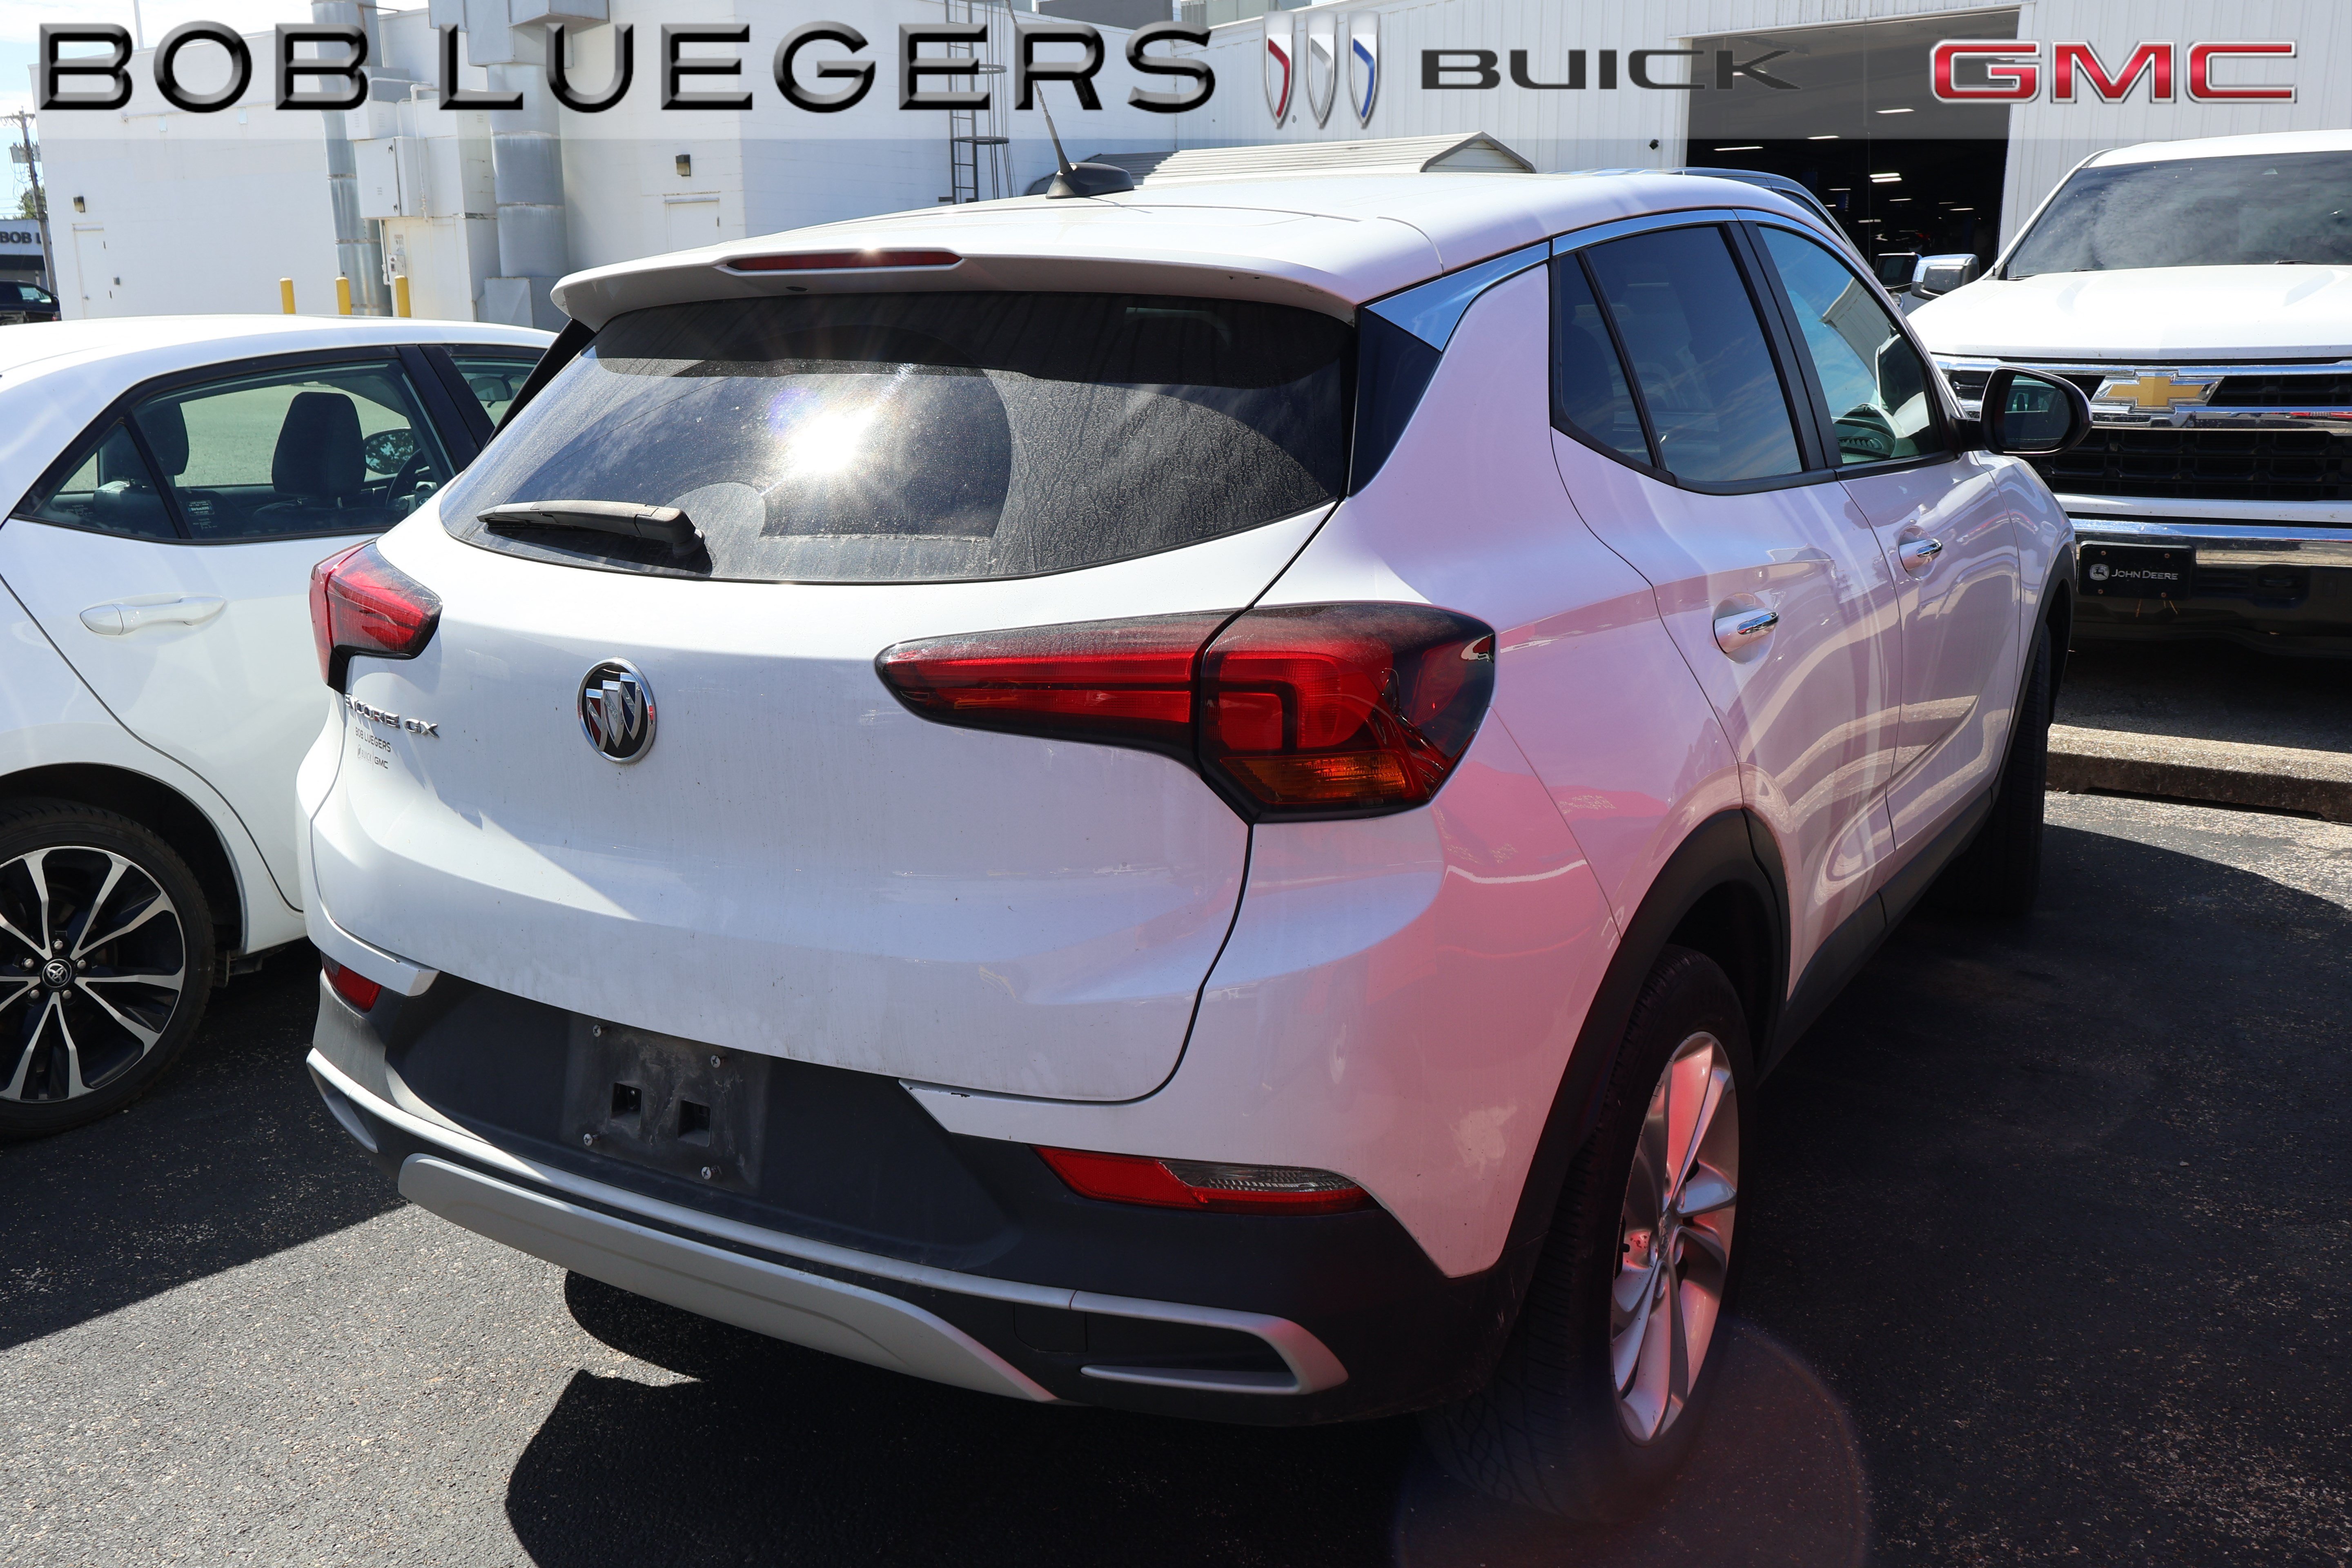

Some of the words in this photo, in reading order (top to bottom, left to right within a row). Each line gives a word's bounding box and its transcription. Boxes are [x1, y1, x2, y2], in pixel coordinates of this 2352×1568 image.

[0, 231, 32, 244] BOB
[2111, 569, 2140, 578] JOHN
[2142, 570, 2178, 580] DEERE
[345, 693, 401, 729] ENCORE
[404, 718, 440, 738] GX
[355, 726, 364, 739] BOB
[365, 734, 391, 753] LUEGERS
[361, 749, 372, 762] BUICK
[374, 756, 389, 770] GMC
